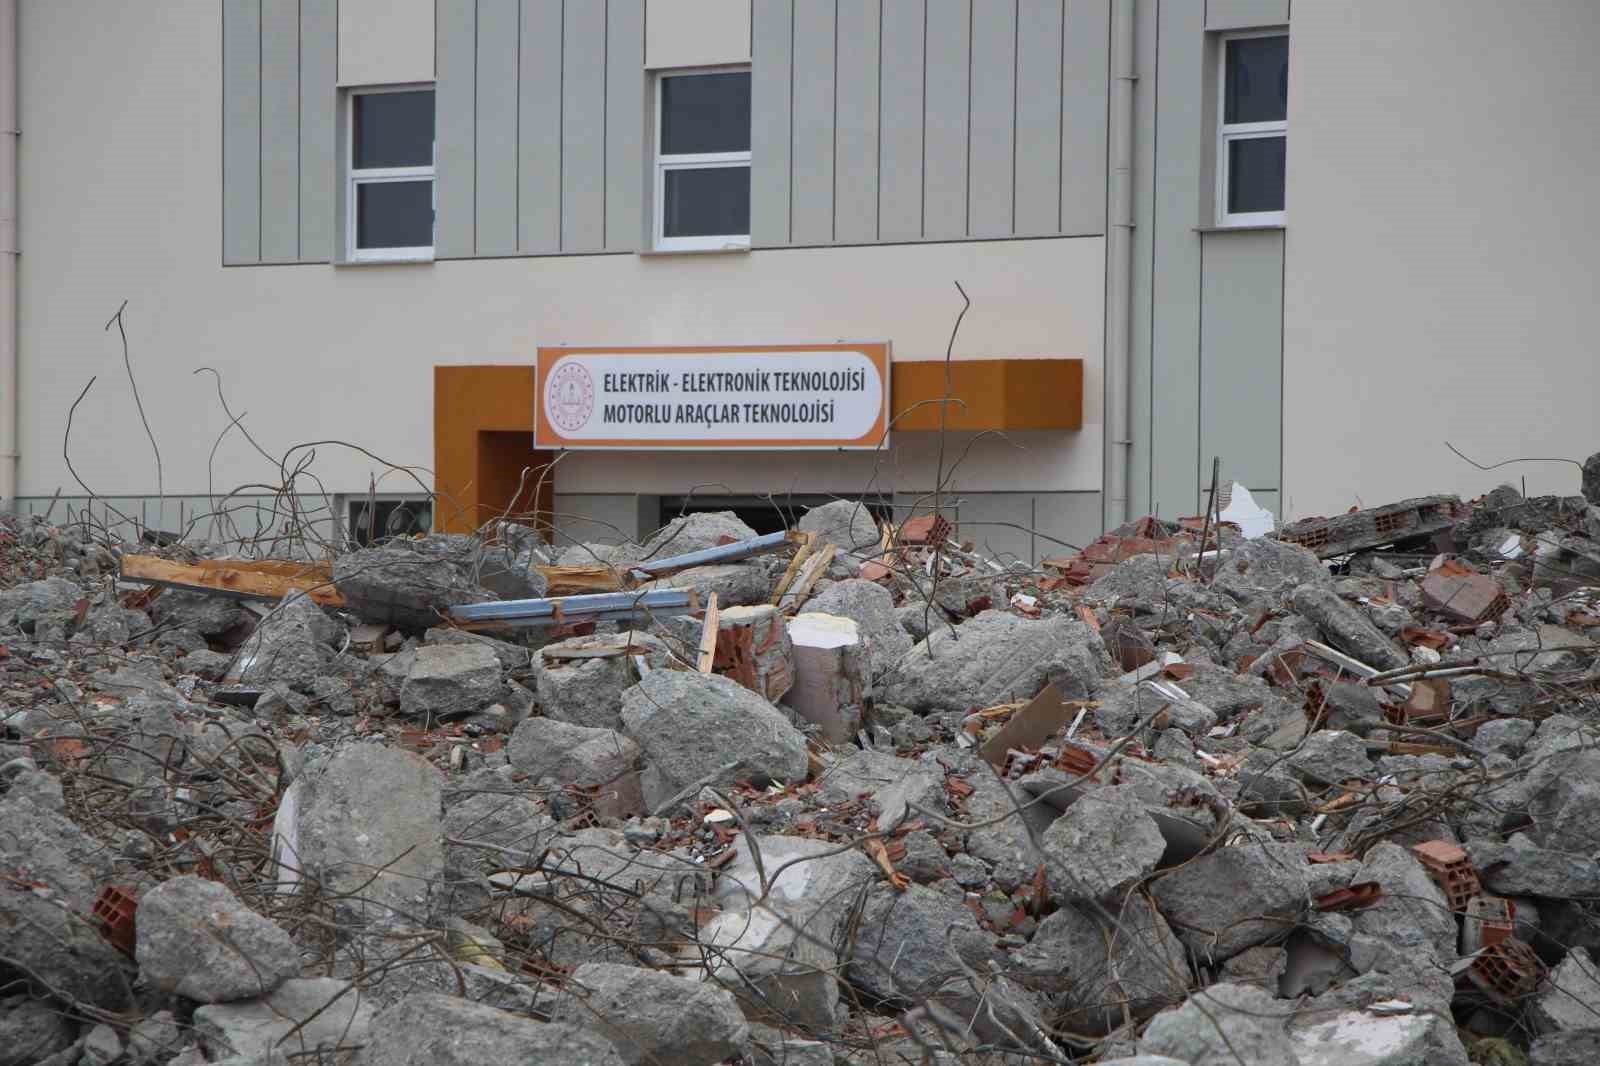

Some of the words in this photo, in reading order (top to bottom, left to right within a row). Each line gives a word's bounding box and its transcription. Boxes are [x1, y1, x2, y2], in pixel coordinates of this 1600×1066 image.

[603, 370, 670, 393] ELEKTRİK
[682, 369, 770, 392] ELEKTRONİK
[774, 367, 865, 392] TEKNOLOJİSİ
[603, 404, 671, 424] MOTORLU
[675, 403, 740, 429] ARAÇLAR
[744, 400, 835, 424] TEKNOLOJİSİ
